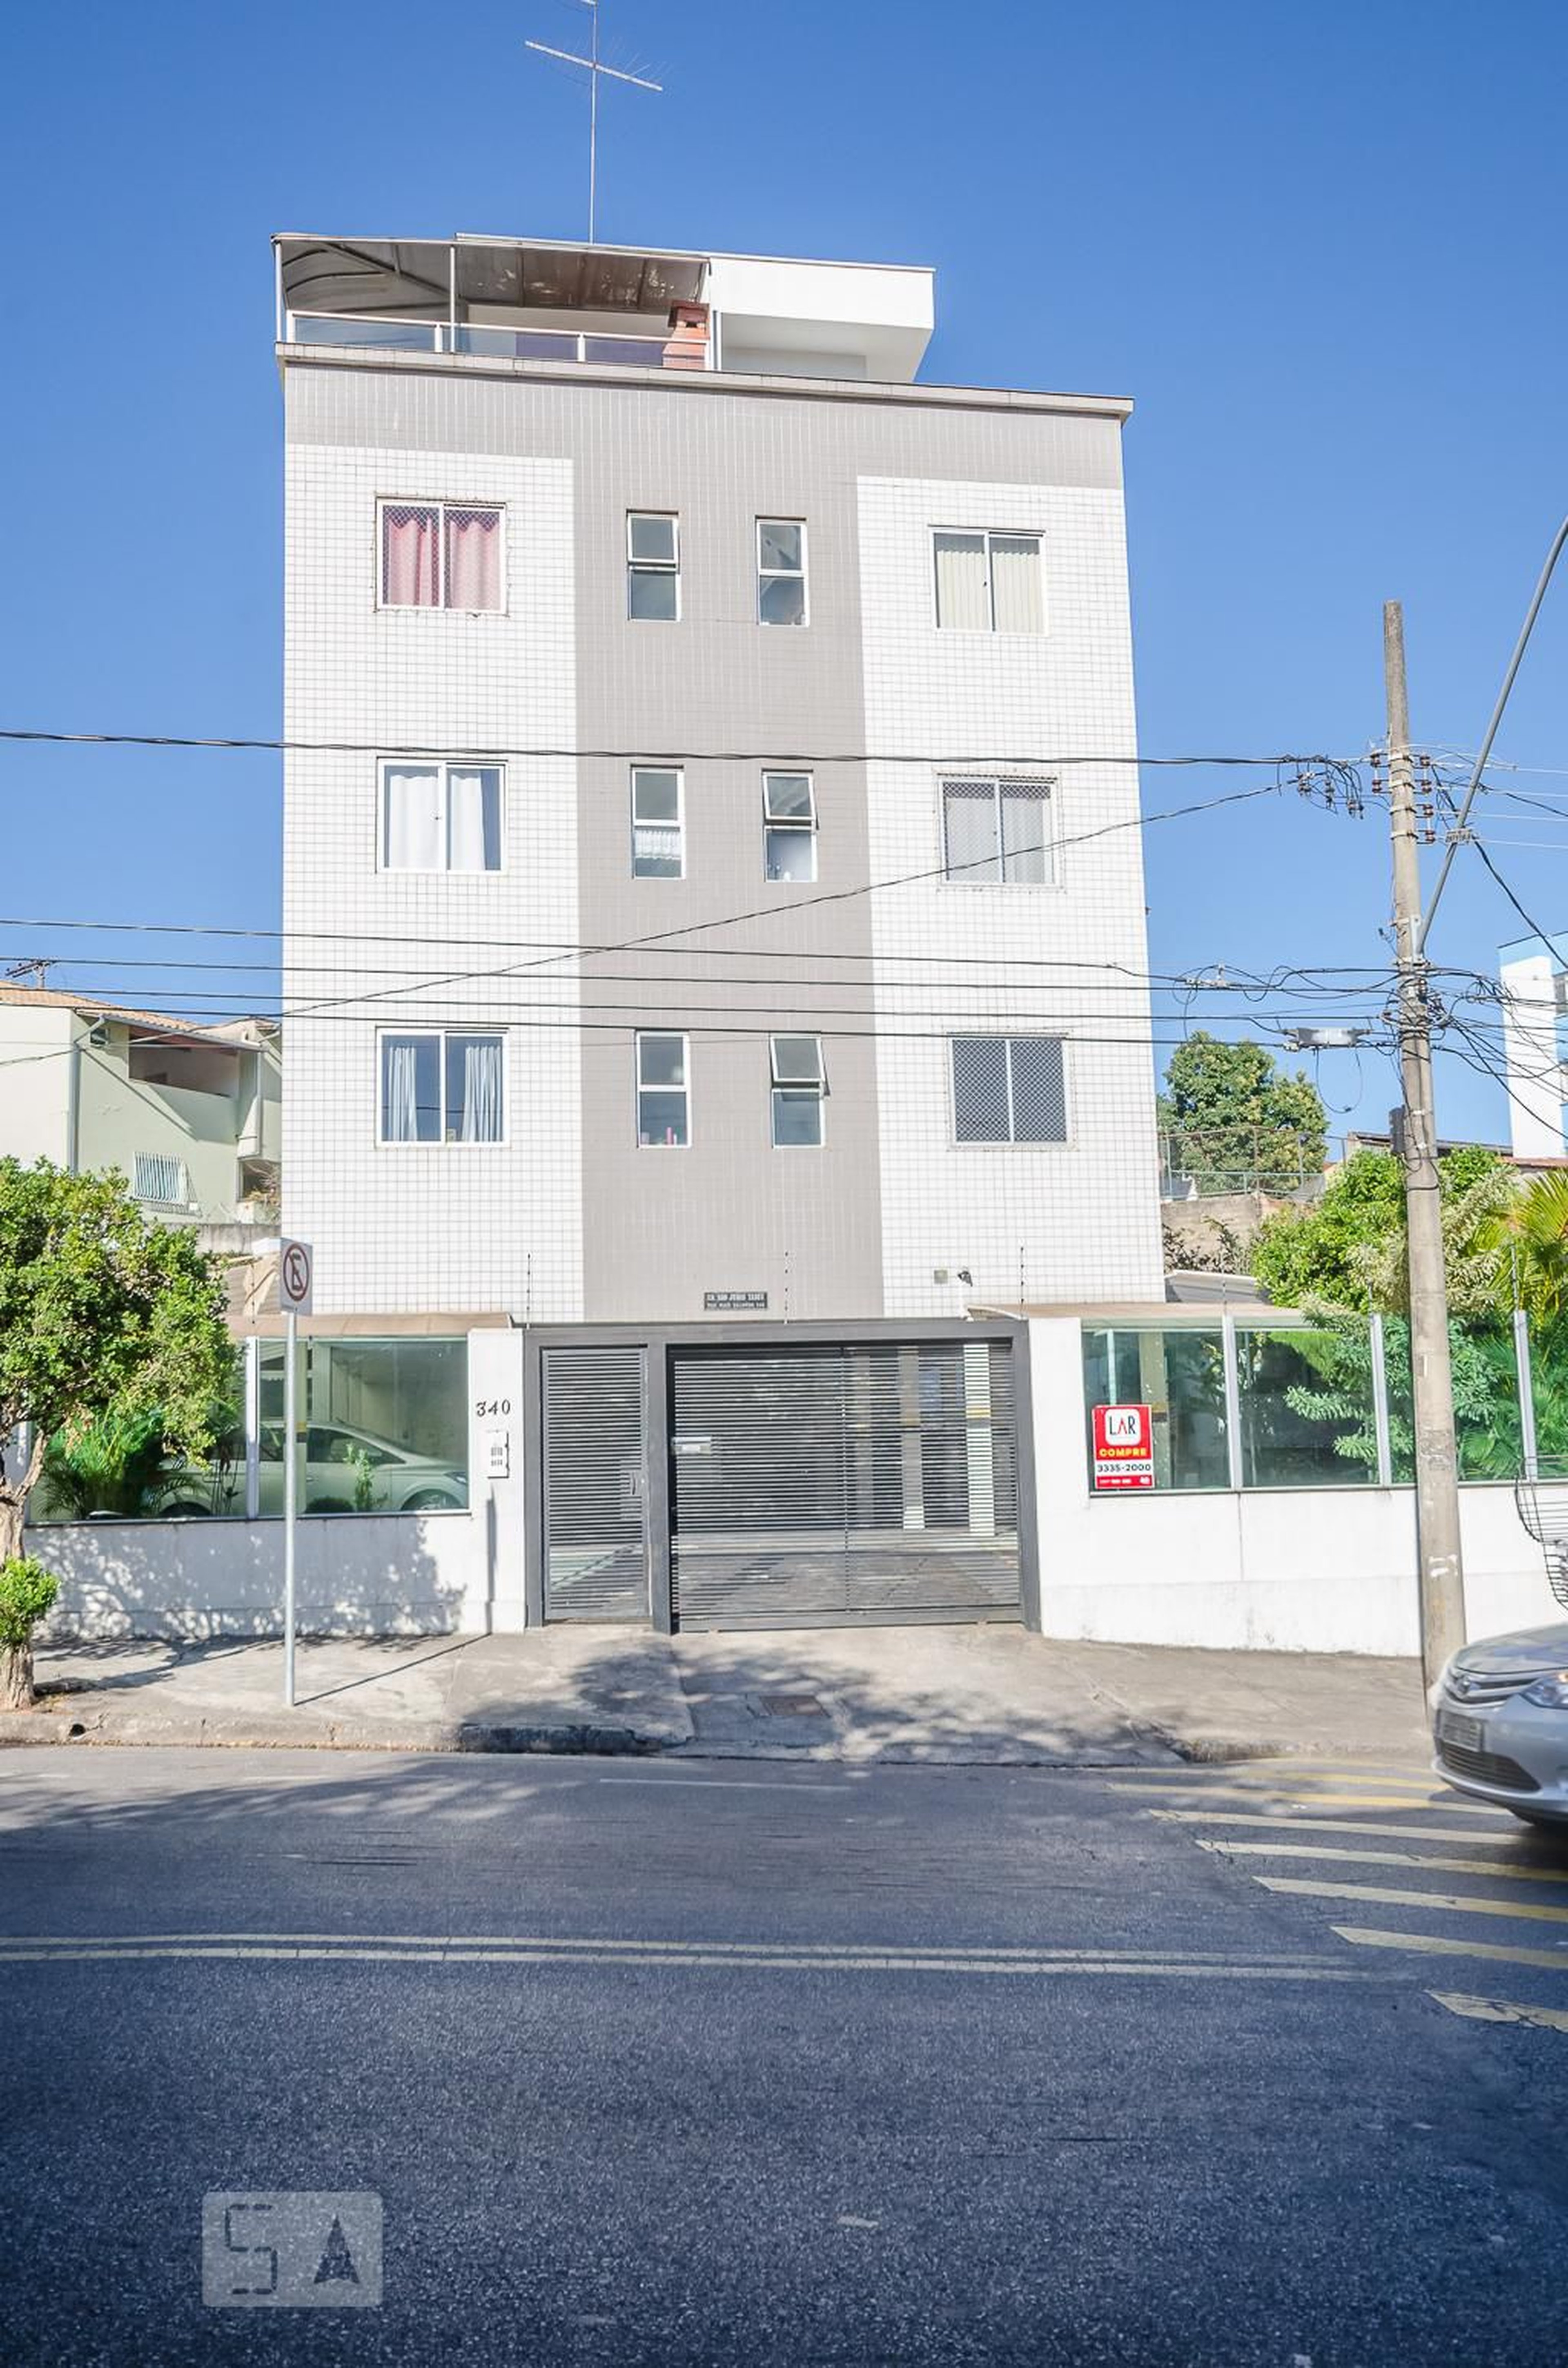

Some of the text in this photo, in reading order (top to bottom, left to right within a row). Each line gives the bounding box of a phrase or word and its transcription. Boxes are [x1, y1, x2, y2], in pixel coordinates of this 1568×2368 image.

[476, 1399, 510, 1417] 340
[1109, 1416, 1136, 1435] LAR
[1099, 1448, 1146, 1456] COMPRE
[1097, 1464, 1151, 1472] 3335-2000
